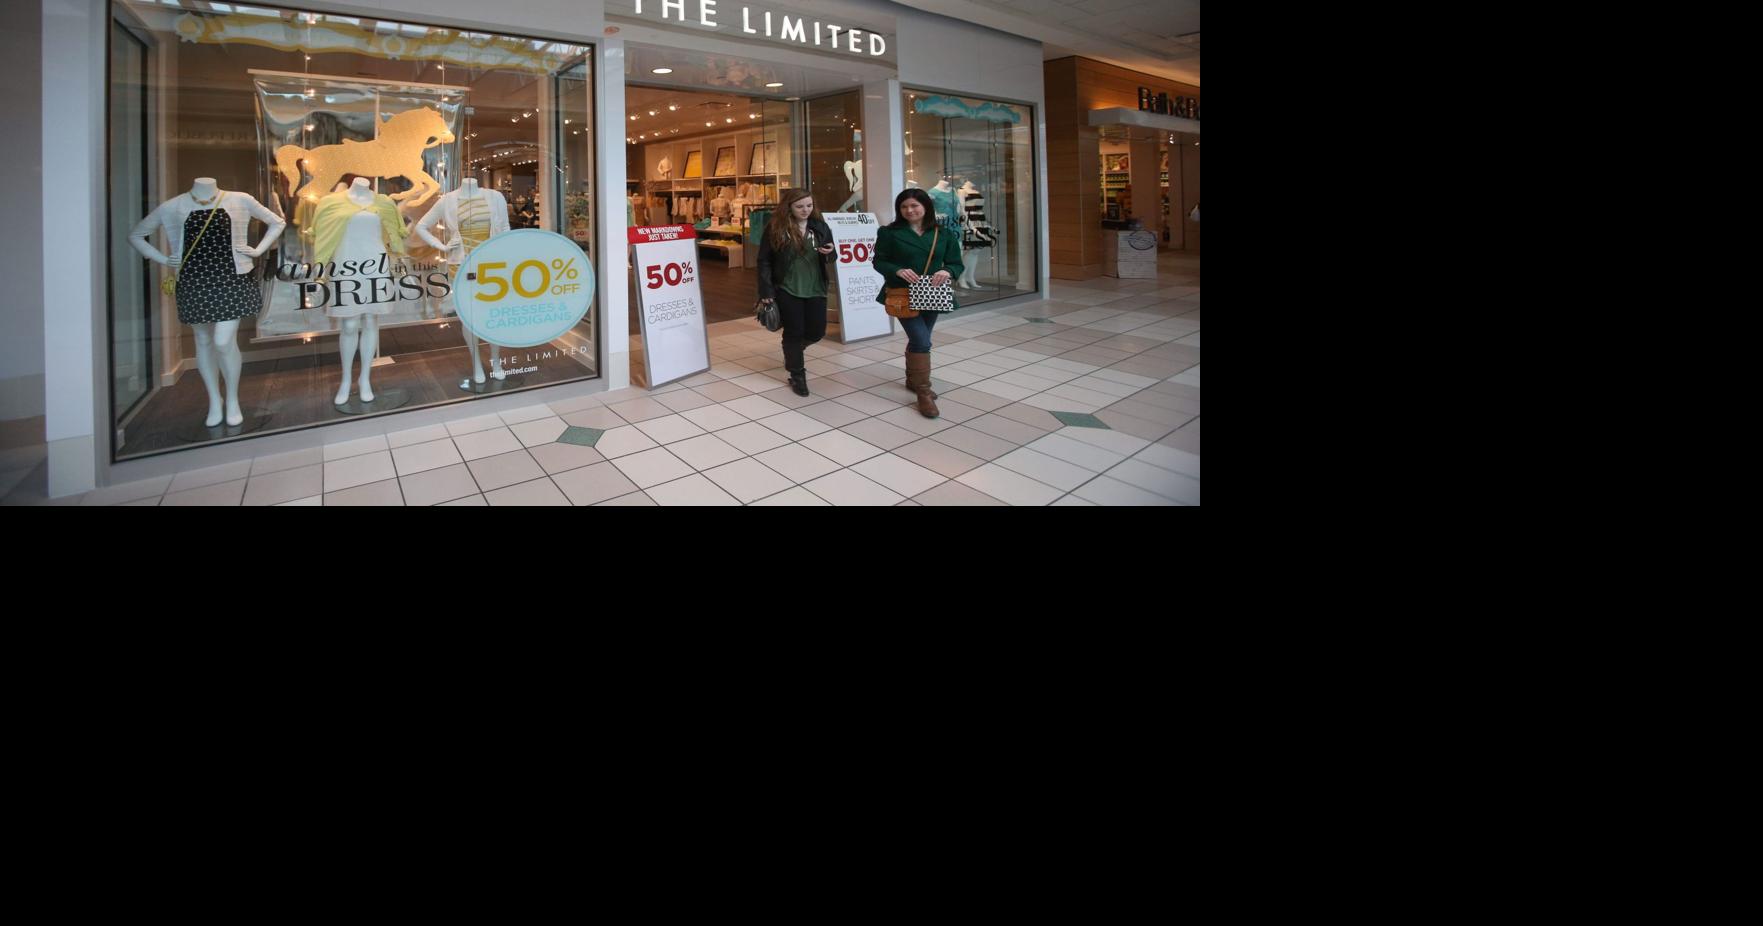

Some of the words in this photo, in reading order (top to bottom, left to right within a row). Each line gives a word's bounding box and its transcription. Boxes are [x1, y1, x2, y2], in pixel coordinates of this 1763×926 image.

[742, 7, 886, 56] LIMITED
[393, 260, 407, 273] in
[412, 262, 439, 273] this
[646, 261, 693, 290] 50%
[474, 257, 578, 303] 50%
[551, 283, 581, 296] OFF
[294, 272, 451, 311] DRESS
[847, 286, 873, 296] SKIRTS
[848, 296, 876, 305] SHORT
[489, 303, 553, 319] DRESSES
[558, 302, 569, 311] &
[647, 306, 698, 325] CARDIGANS
[649, 298, 688, 314] DRESSES
[689, 298, 695, 306] &
[485, 311, 573, 330] CARDIGANS
[489, 355, 518, 367] THE
[526, 345, 587, 362] LIMITED
